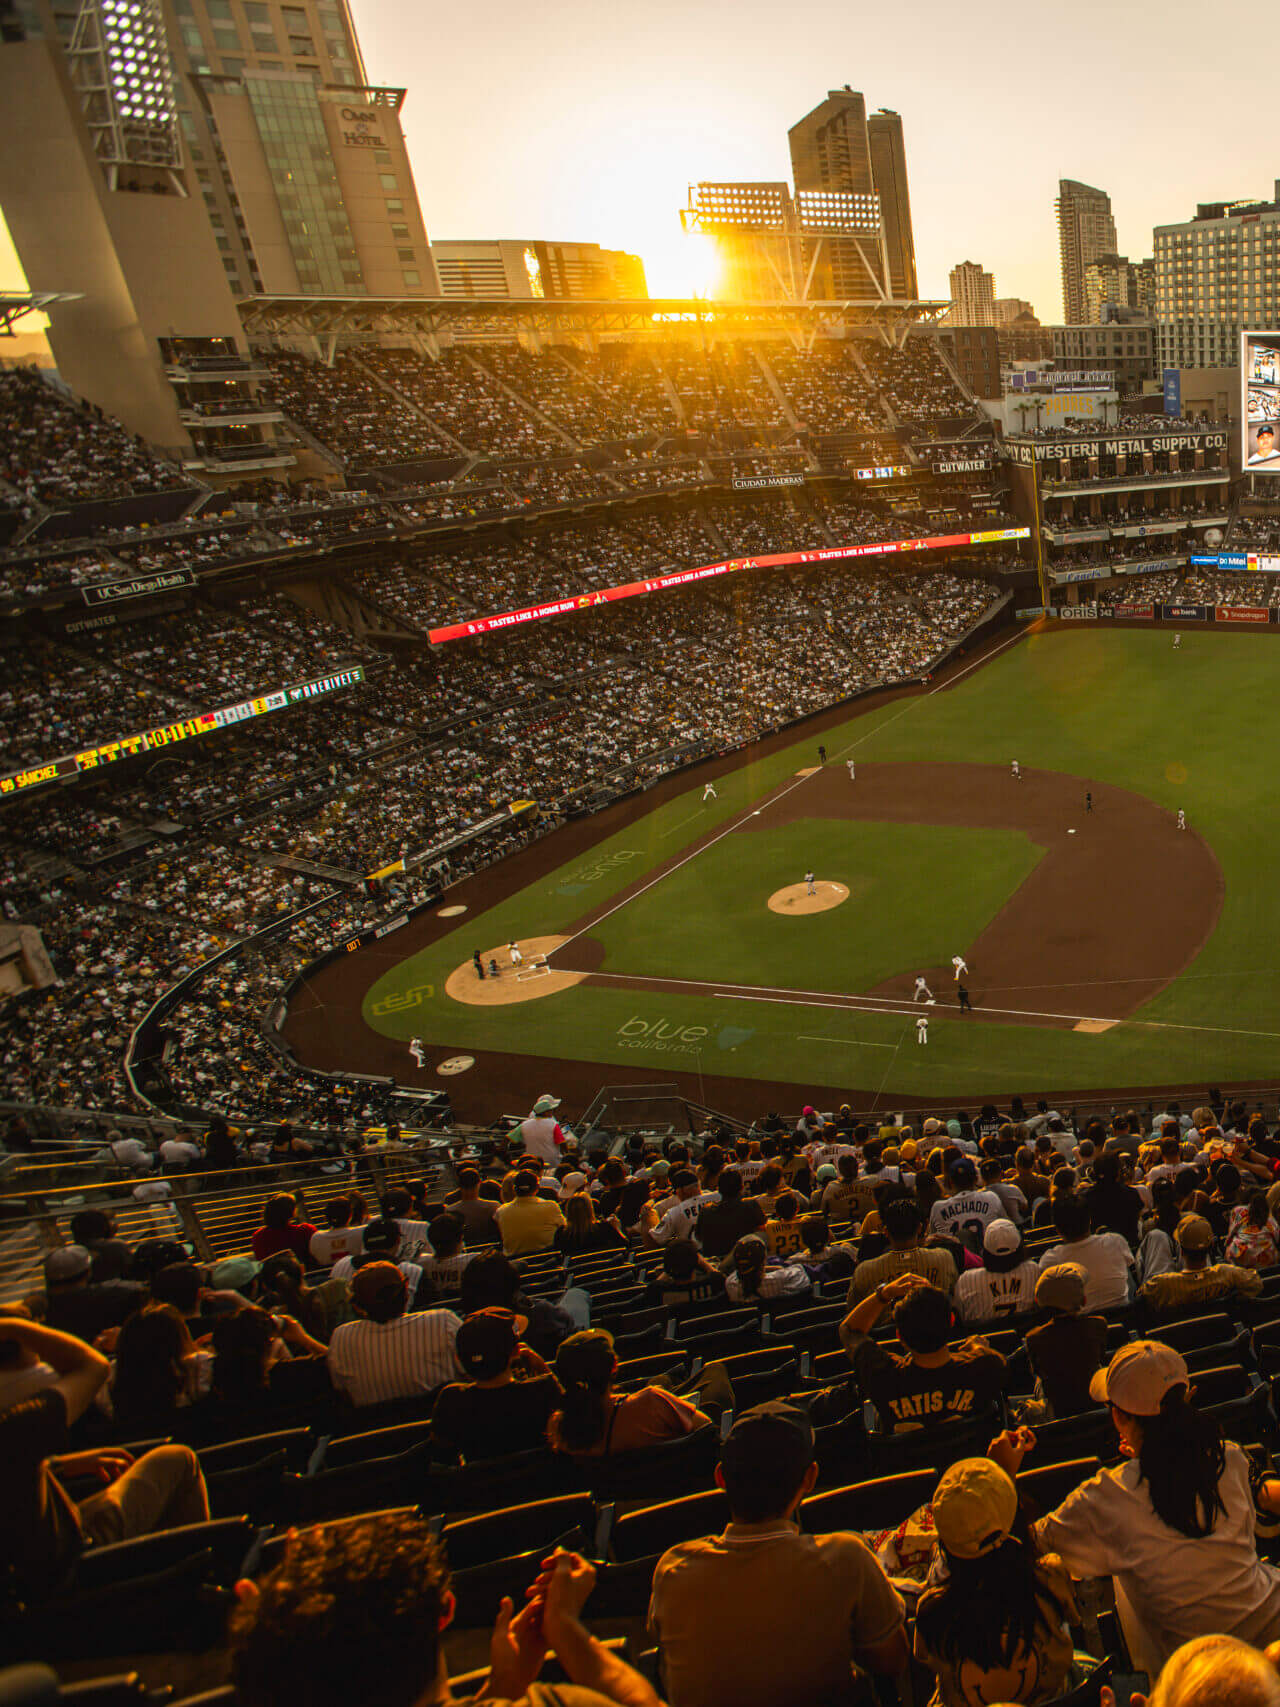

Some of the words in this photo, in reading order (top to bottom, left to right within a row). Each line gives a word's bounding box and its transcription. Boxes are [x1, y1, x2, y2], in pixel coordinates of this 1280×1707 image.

[341, 108, 376, 122] OMNI
[343, 131, 385, 146] HOTEL
[1046, 395, 1094, 416] PADRES
[1035, 442, 1099, 460] WESTERN
[1105, 439, 1149, 455] METAL
[1152, 436, 1200, 451] SUPPLY
[1205, 434, 1227, 449] CO.
[940, 459, 985, 473] CUTWATER
[735, 477, 766, 489] CIUDAD
[768, 475, 803, 486] MADERAS
[819, 550, 842, 559] TASTES
[843, 548, 857, 557] LIKE
[1228, 557, 1246, 565] Mitel
[488, 616, 516, 628] TASTES
[516, 612, 533, 622] LIKE
[539, 606, 561, 618] HOME
[560, 602, 575, 612] RUN
[1062, 608, 1096, 619] ORIS
[65, 614, 117, 633] CUTWATER
[156, 731, 165, 746] 0
[0, 780, 15, 793] 99
[15, 765, 60, 788] SÁNCHEZ
[615, 1015, 709, 1042] blue
[940, 1199, 990, 1221] MACHADO
[776, 1234, 800, 1252] 23
[990, 1278, 1021, 1297] KIM
[888, 1390, 944, 1420] TATIS
